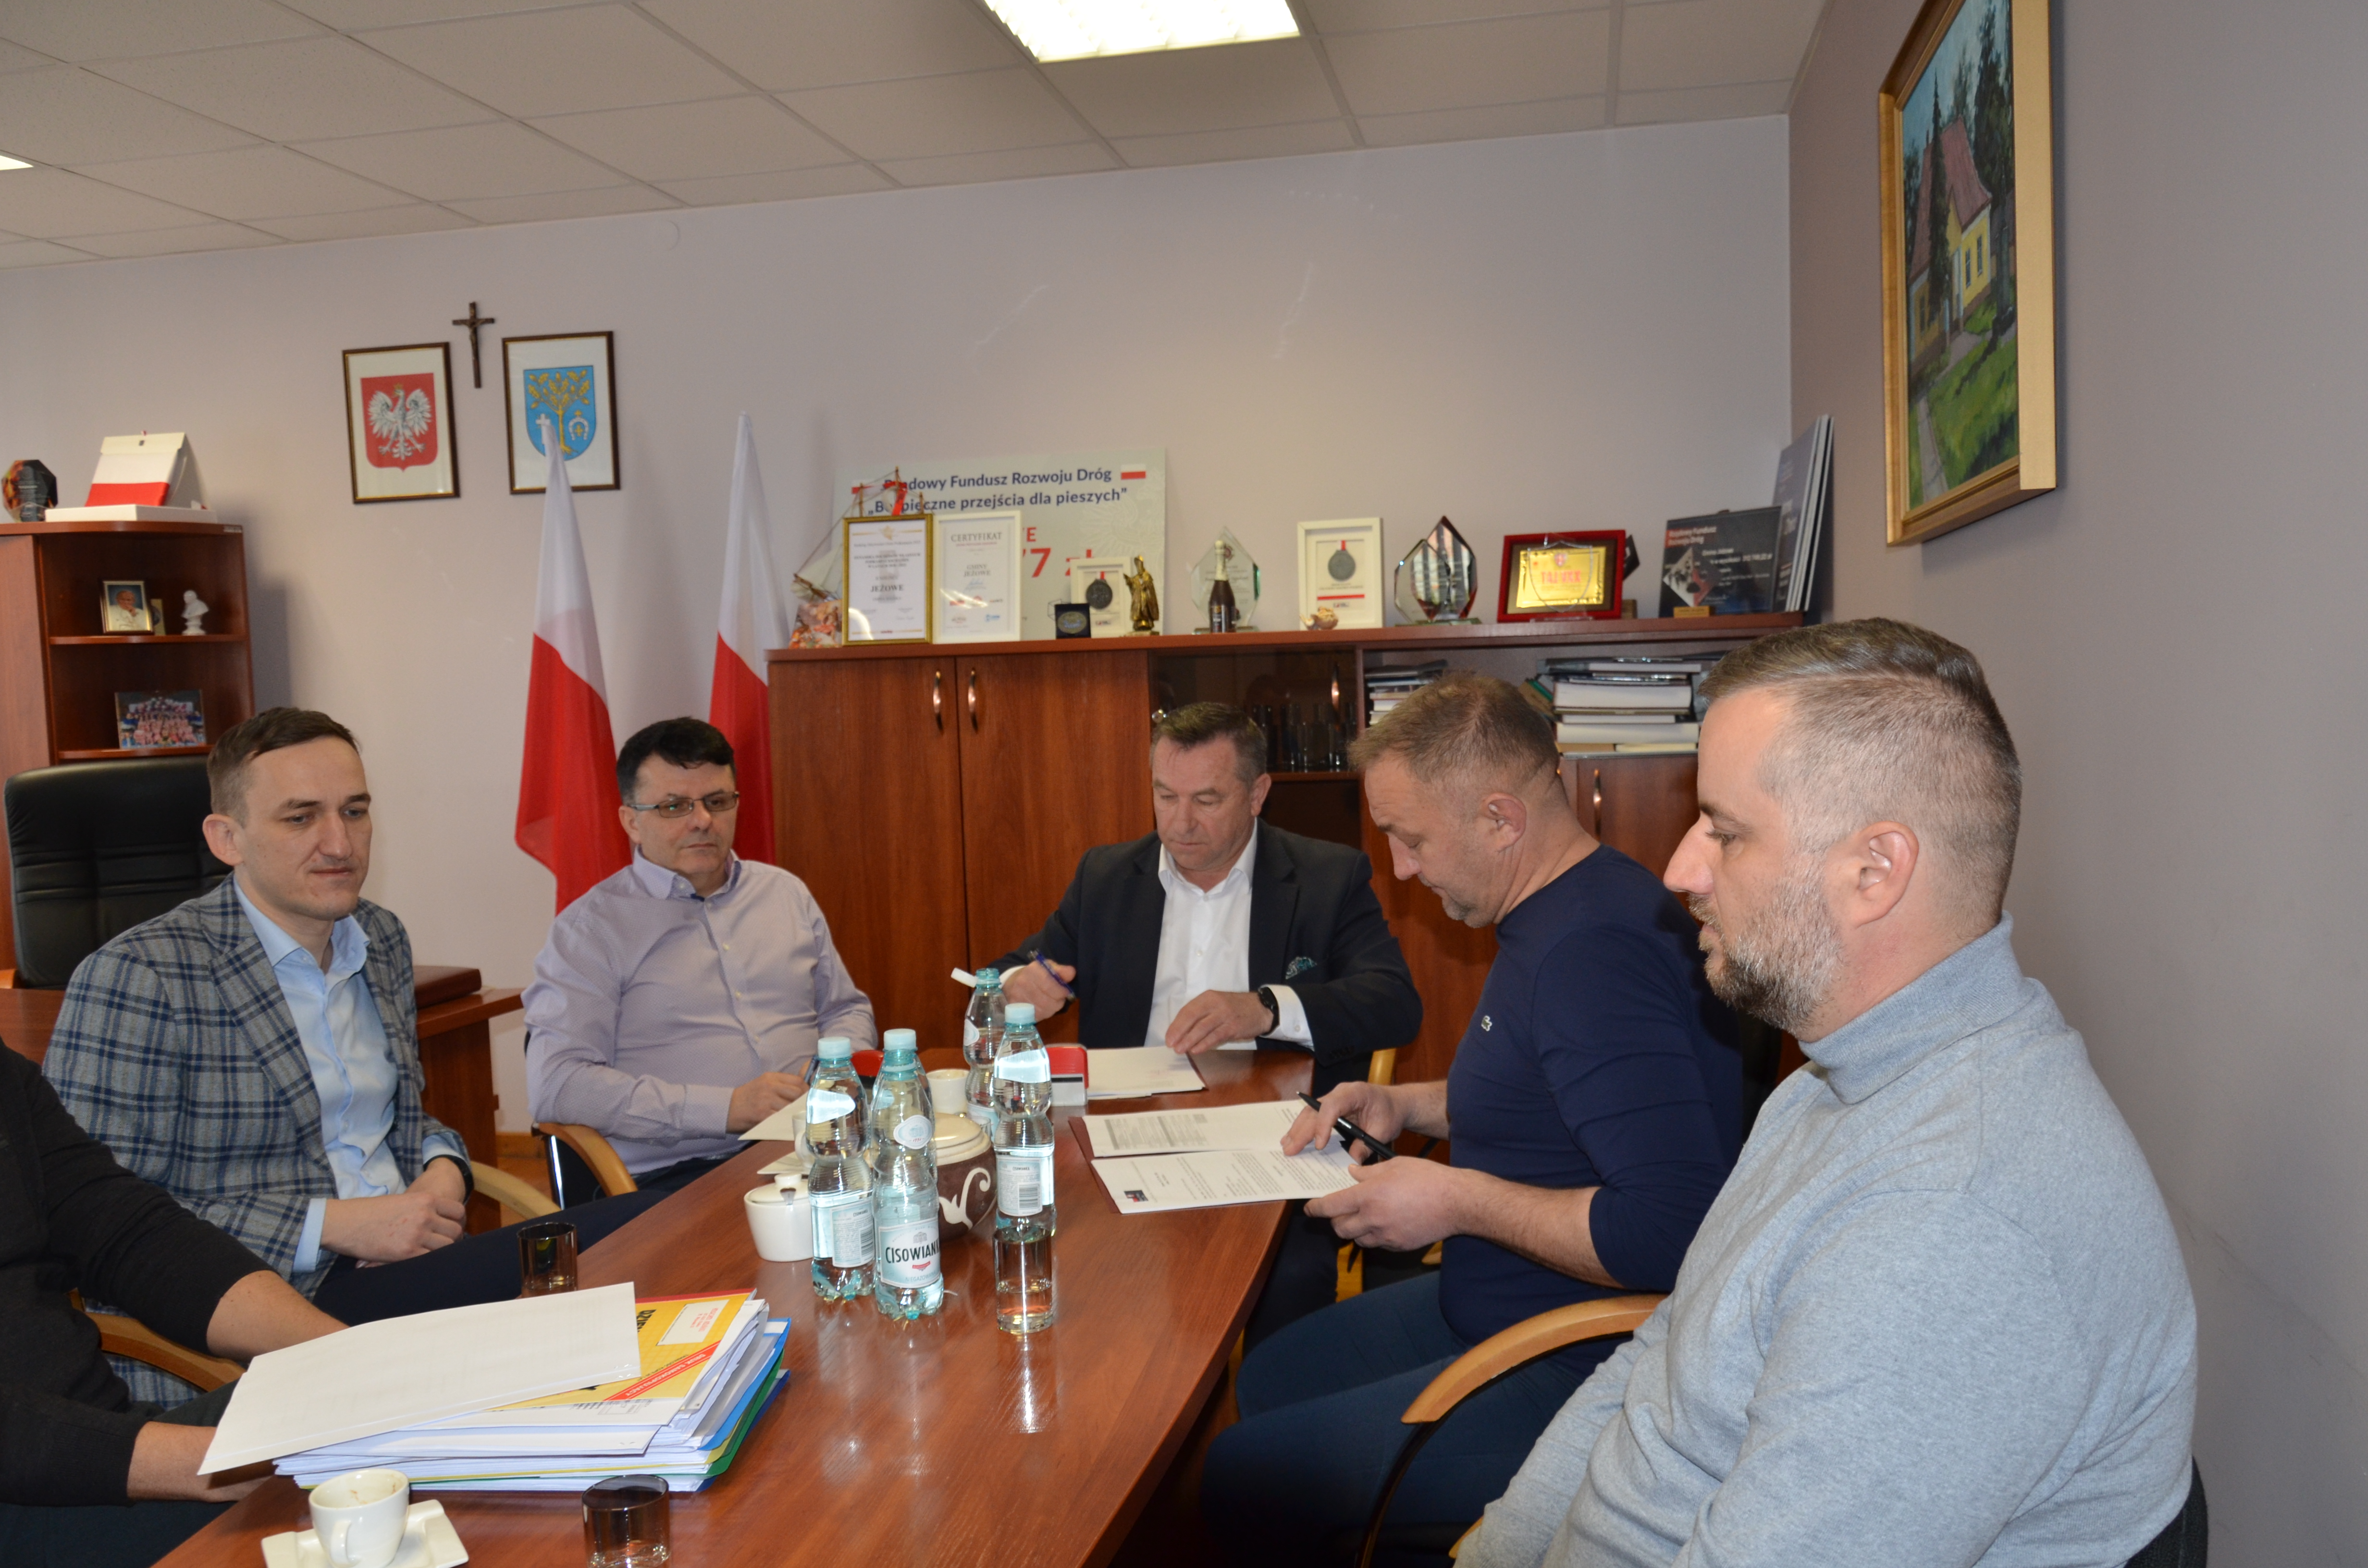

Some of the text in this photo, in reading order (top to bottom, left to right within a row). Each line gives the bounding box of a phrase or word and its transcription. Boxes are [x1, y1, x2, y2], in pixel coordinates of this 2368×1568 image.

[884, 468, 1111, 491] dowy Fundusz Rozwoju Dróg
[961, 493, 1024, 510] przejścia
[1030, 492, 1051, 505] dla
[1056, 488, 1127, 506] pieszych”
[951, 532, 1002, 542] CERTYFIKAT
[870, 584, 904, 592] JEŻOWE
[885, 1237, 940, 1263] CISOWIANK
[686, 1354, 706, 1366] DRUK
